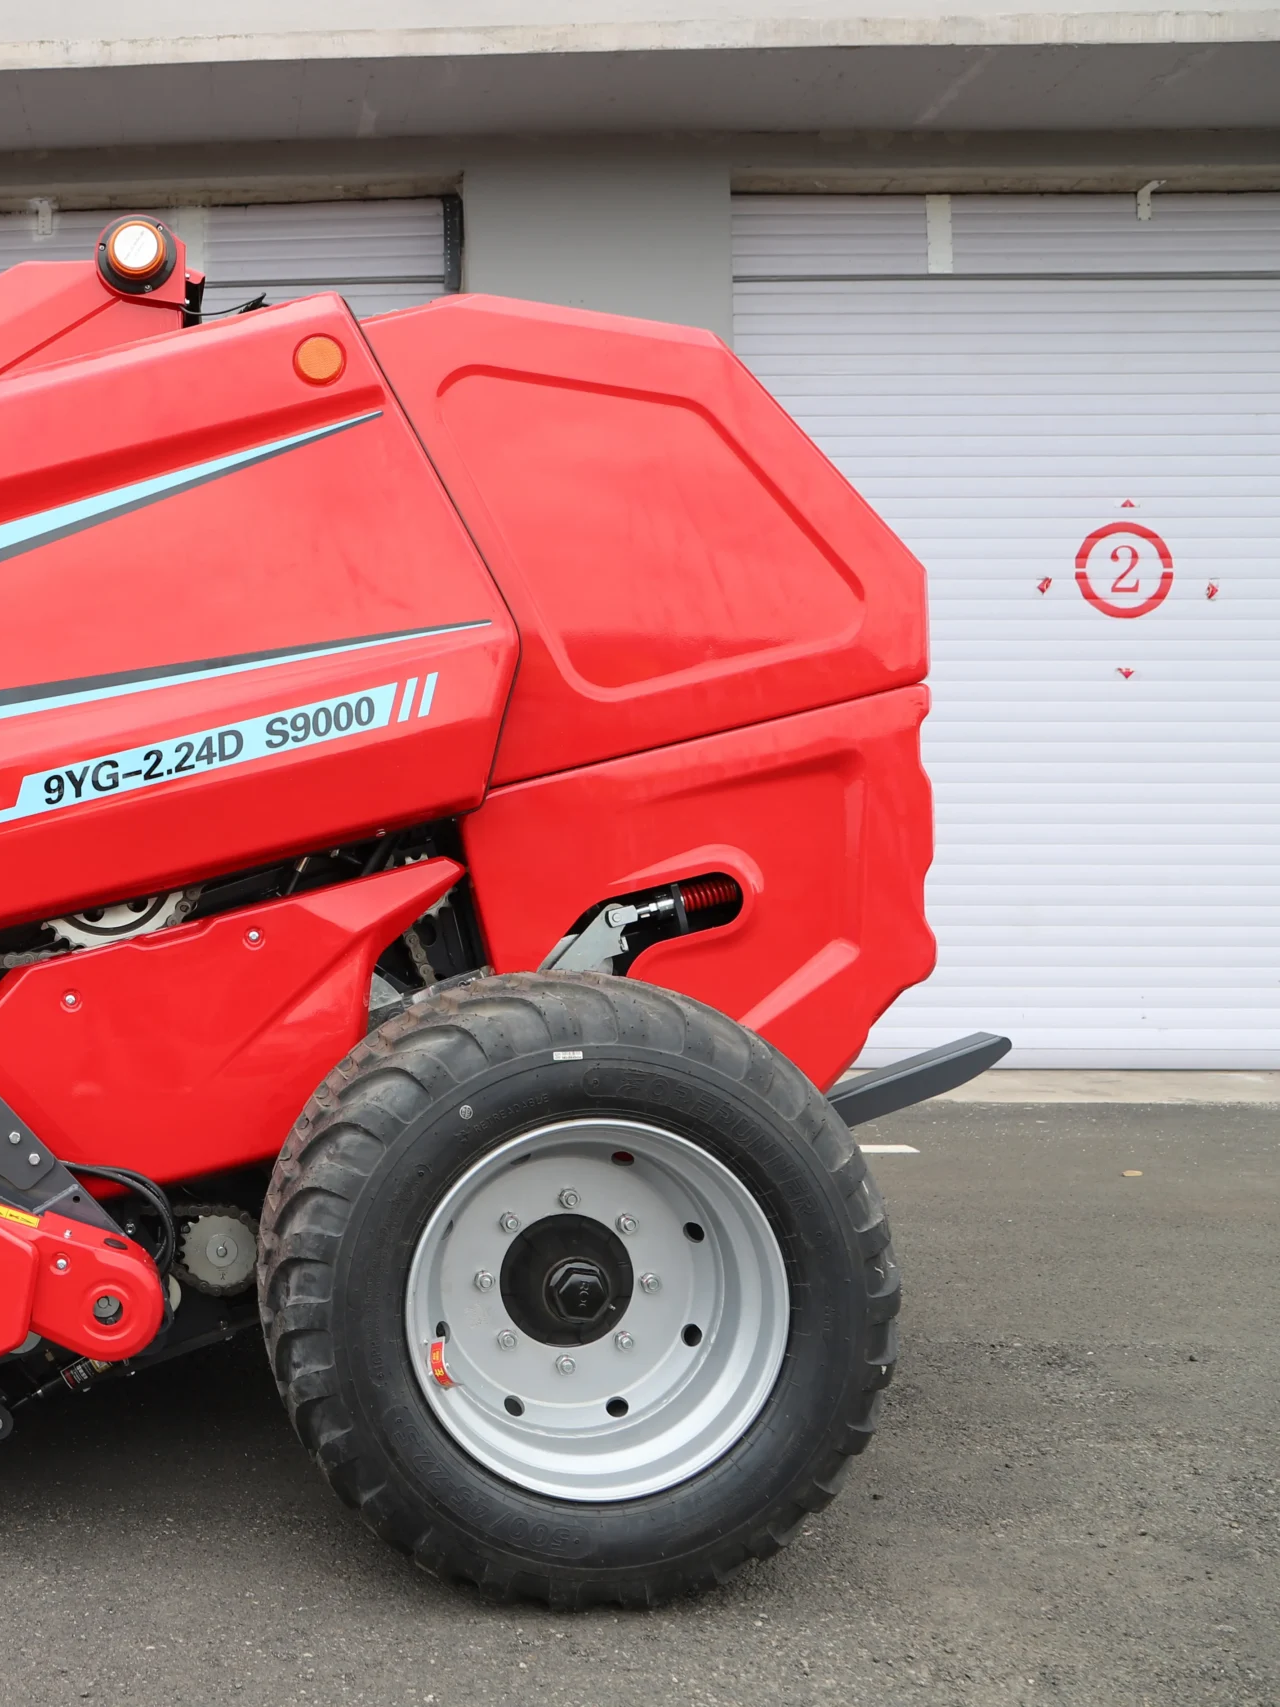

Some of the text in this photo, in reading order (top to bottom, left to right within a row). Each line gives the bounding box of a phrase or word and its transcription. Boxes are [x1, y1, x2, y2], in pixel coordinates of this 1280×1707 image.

[1110, 545, 1140, 593] 2
[43, 697, 375, 805] 9YG-2.24D S9000
